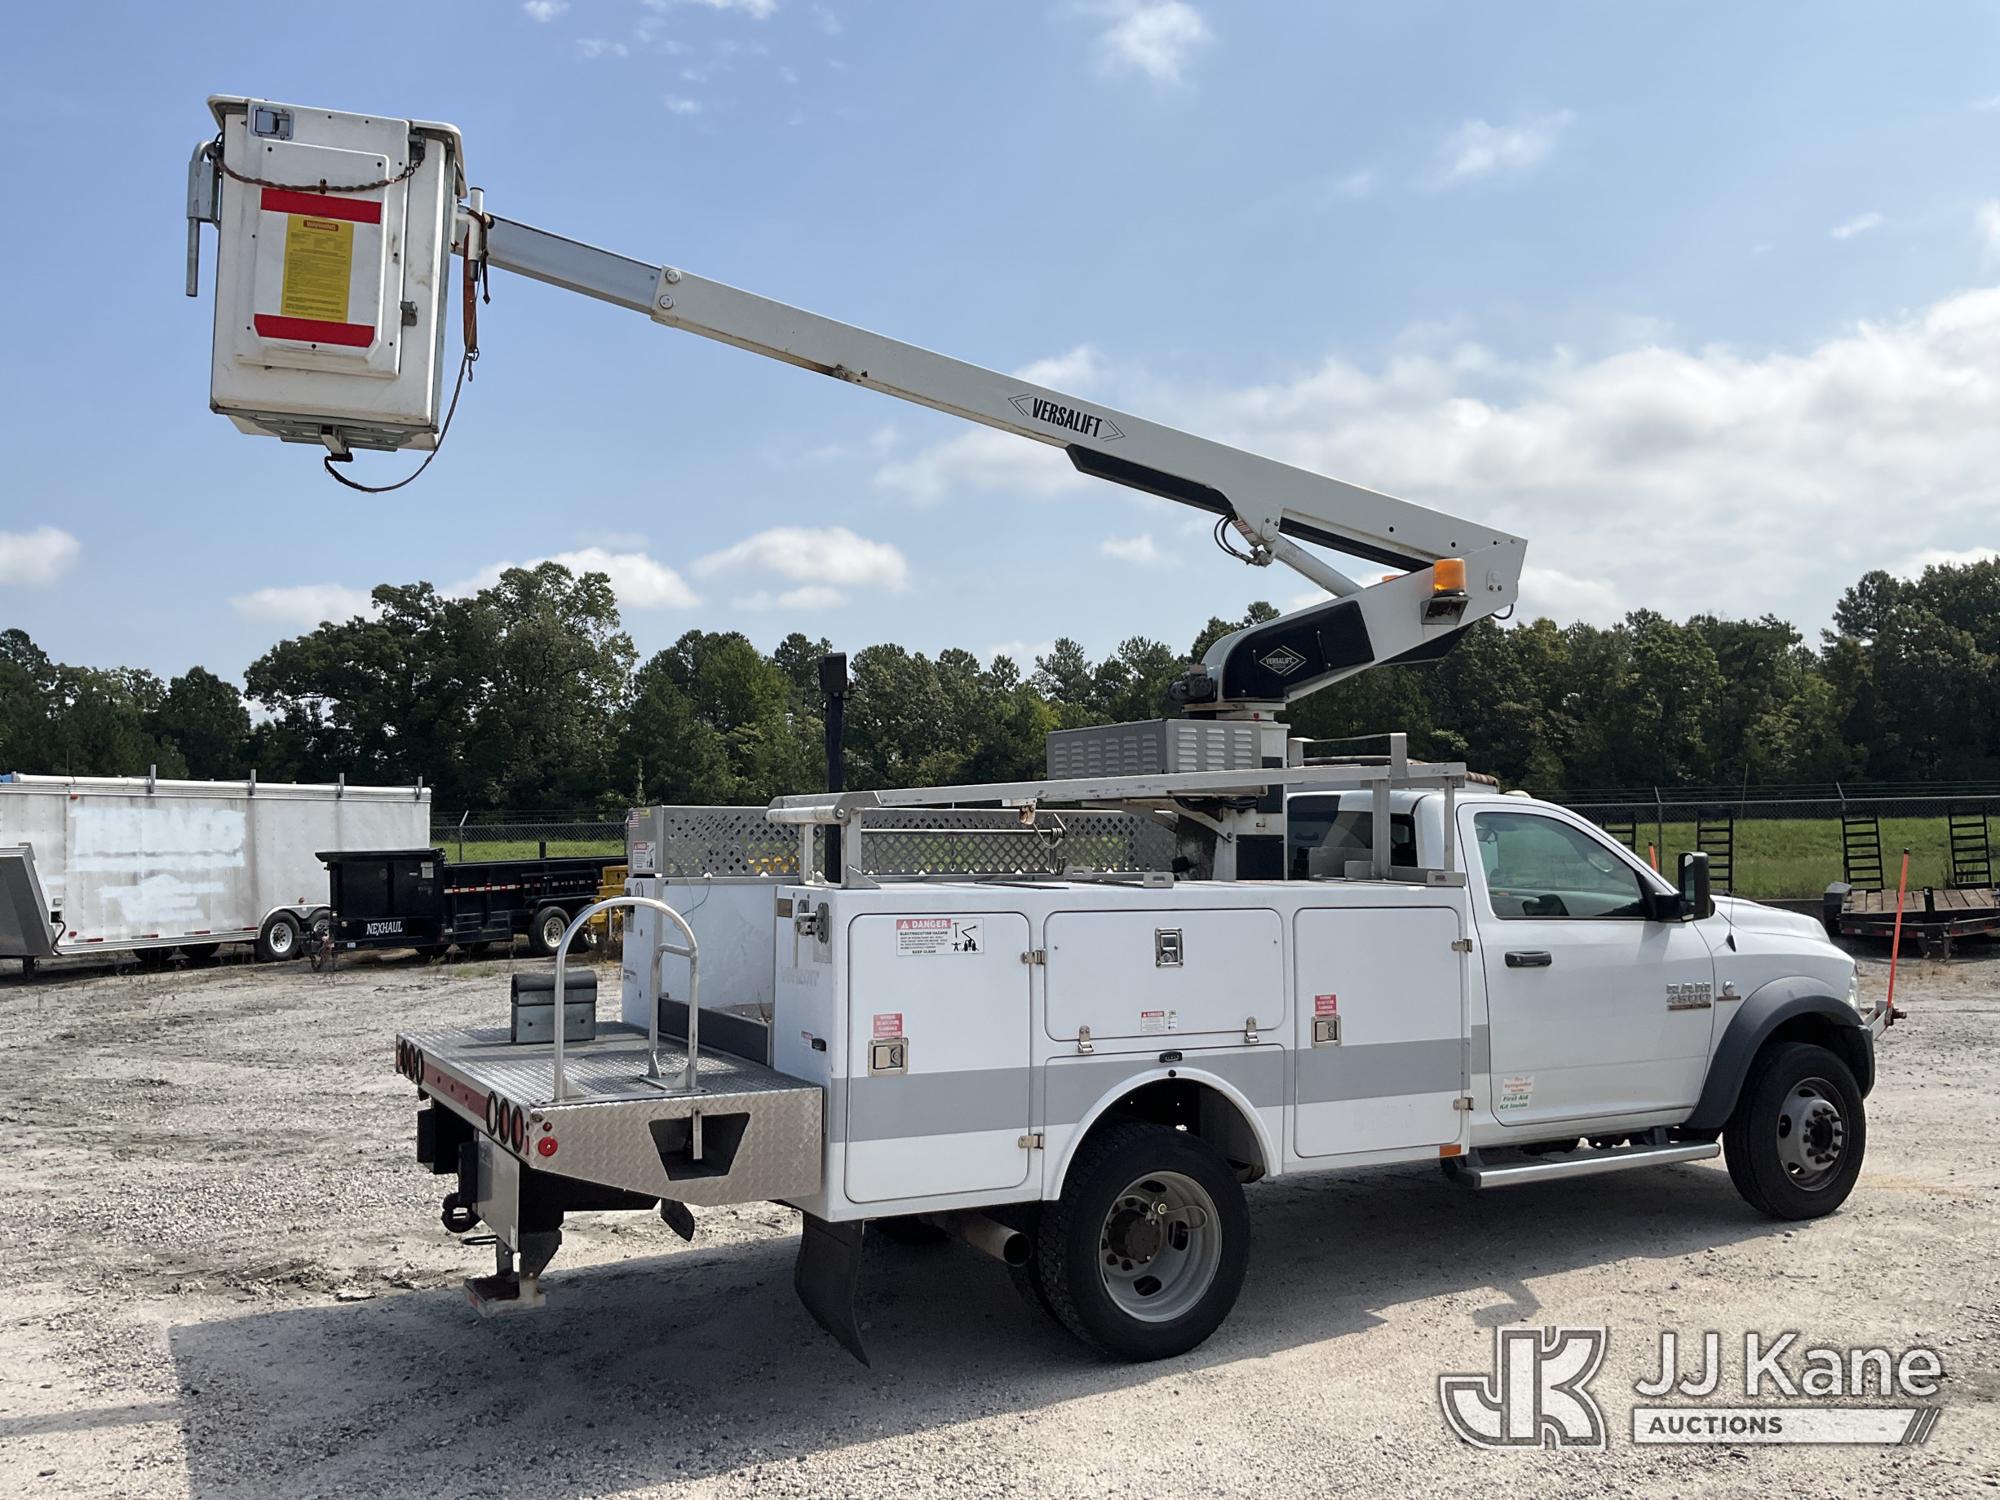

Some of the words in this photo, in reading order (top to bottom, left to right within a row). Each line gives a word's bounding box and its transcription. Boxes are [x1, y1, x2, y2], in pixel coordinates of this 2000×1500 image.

[1033, 398, 1102, 437] VERSALIFT
[366, 921, 403, 936] NEXHAUL
[912, 920, 948, 929] DANGER
[1666, 982, 1711, 994] RAM
